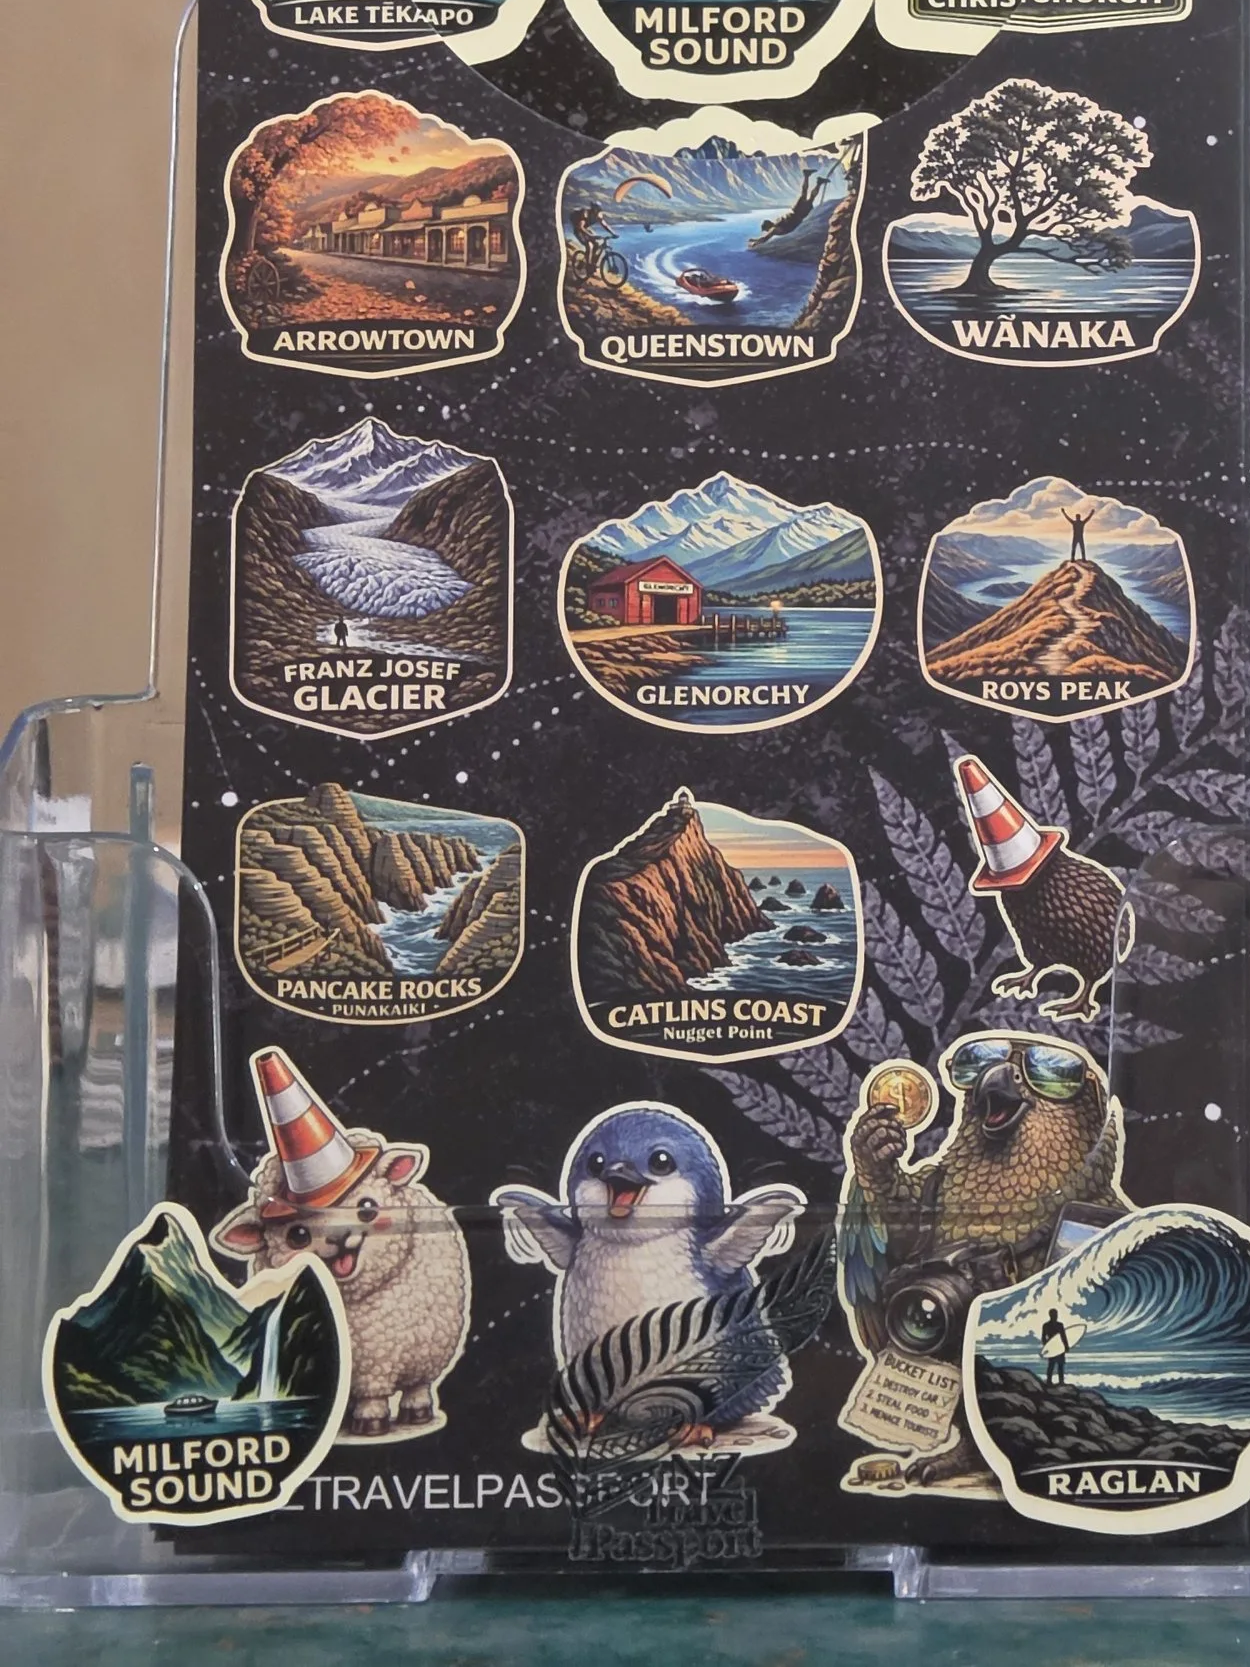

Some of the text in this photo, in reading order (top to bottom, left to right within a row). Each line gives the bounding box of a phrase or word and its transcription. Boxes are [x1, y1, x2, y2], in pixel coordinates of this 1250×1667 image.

[295, 5, 359, 25] LAKE
[635, 6, 806, 34] MILFORD
[649, 38, 788, 65] SOUND
[273, 329, 475, 352] ARROWTOWN
[600, 335, 815, 364] QUEENSTOWN
[284, 659, 461, 683] FRANZ JOSEF
[293, 684, 446, 711] GLACIER
[636, 683, 810, 706] GLENORCHY
[981, 680, 1132, 701] ROYS PEAK
[277, 977, 482, 1000] PANCAKE ROCKS
[332, 1002, 426, 1017] PUNAKAIKI
[608, 999, 827, 1028] CATLINS COAST
[663, 1025, 773, 1043] Nugget Point
[884, 1353, 959, 1391] BUCKET LIST
[113, 1435, 291, 1475] MILFORD
[130, 1470, 273, 1506] SOUND
[1048, 1470, 1201, 1497] RAGLAN
